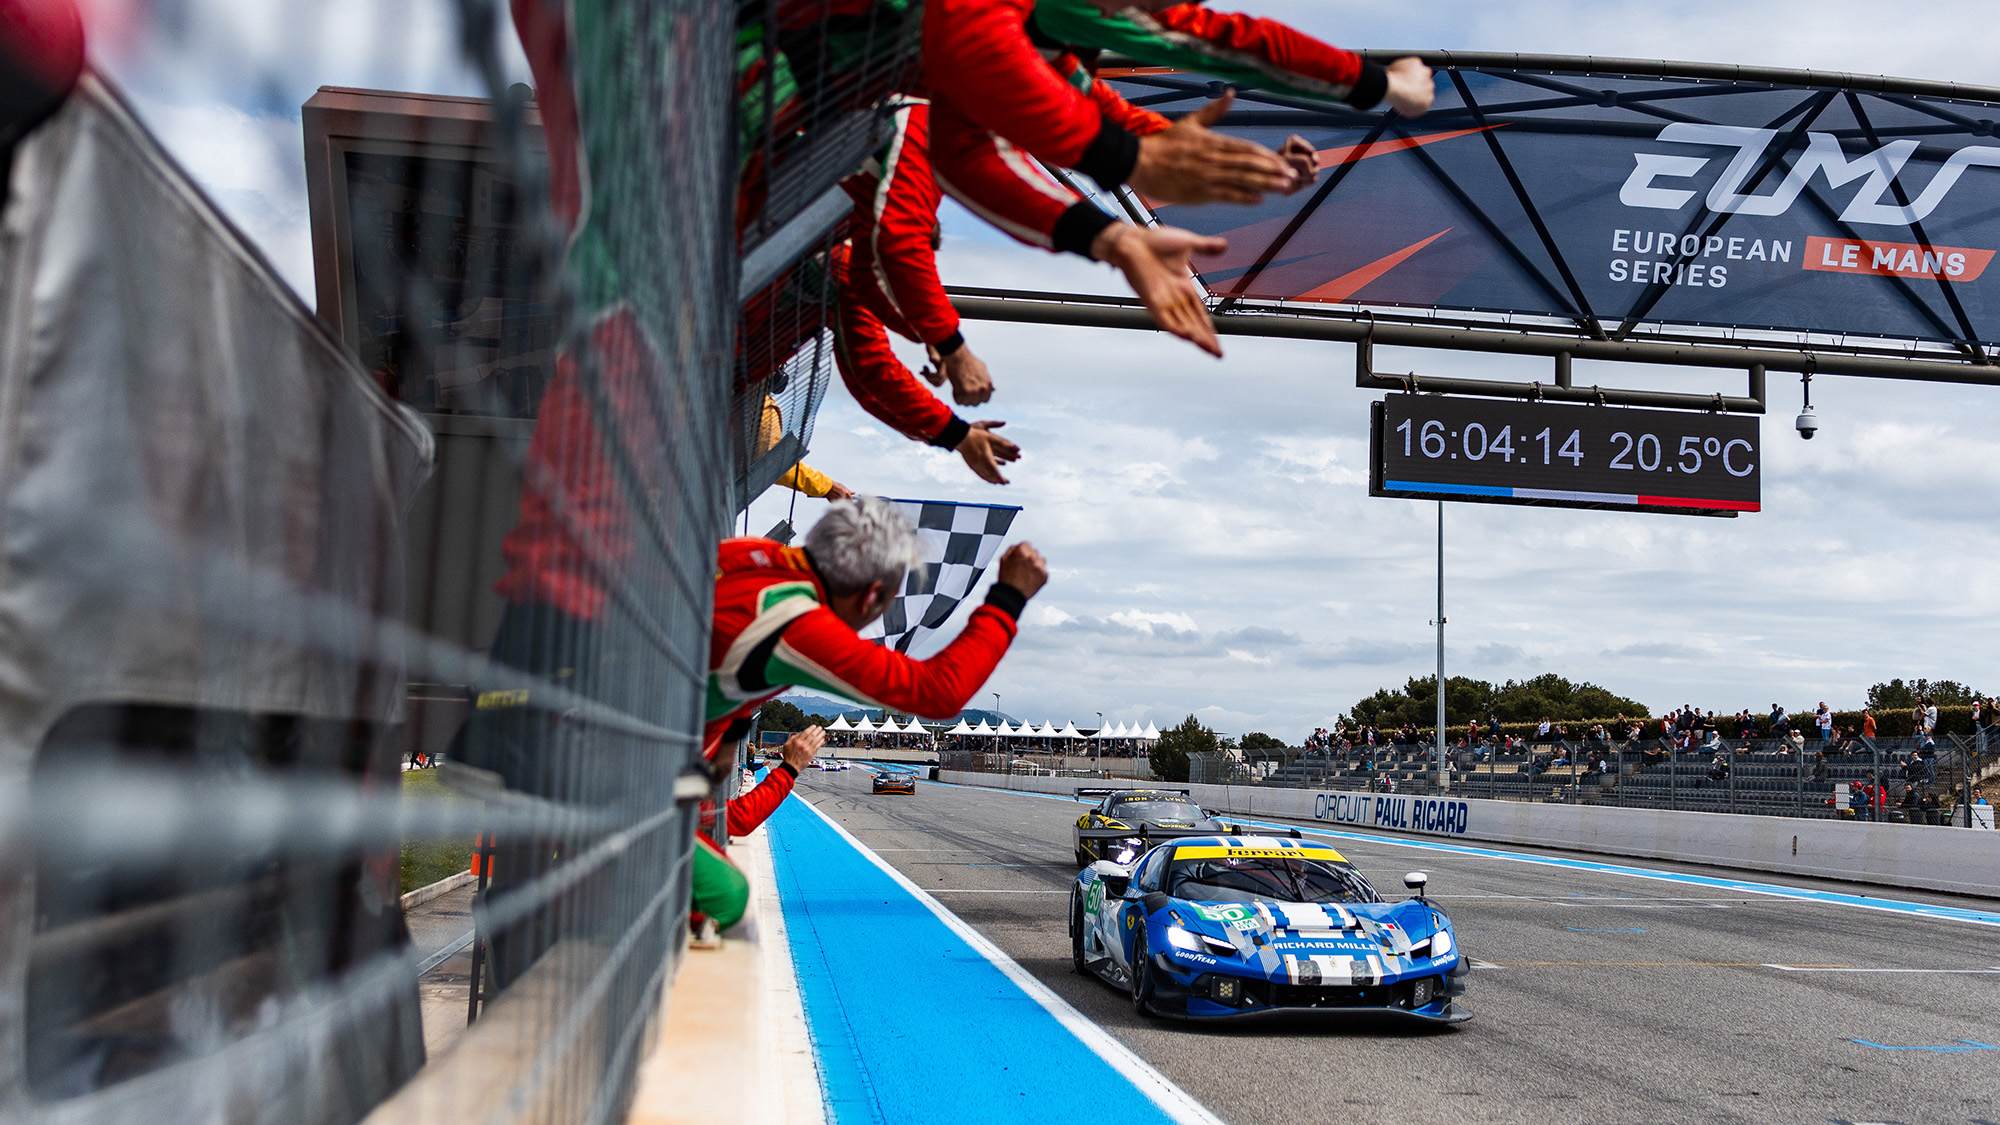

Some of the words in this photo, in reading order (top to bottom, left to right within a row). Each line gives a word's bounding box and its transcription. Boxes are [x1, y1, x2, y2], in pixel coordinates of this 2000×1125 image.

[1612, 229, 1792, 262] EUROPEAN
[1822, 243, 1860, 268] LE
[1872, 247, 1966, 276] MANS
[1609, 259, 1728, 288] SERIES
[1396, 418, 1584, 466] 16:04:14
[1315, 794, 1371, 823] CIRCUIT
[1375, 797, 1407, 828] PAUL
[1412, 800, 1468, 833] RICARD
[1226, 848, 1306, 858] Ferrari
[1087, 883, 1101, 912] 50
[1201, 907, 1245, 921] 50
[1175, 951, 1217, 965] GOODYEAR
[1273, 942, 1335, 950] RICHARD
[1337, 942, 1378, 951] MILLE
